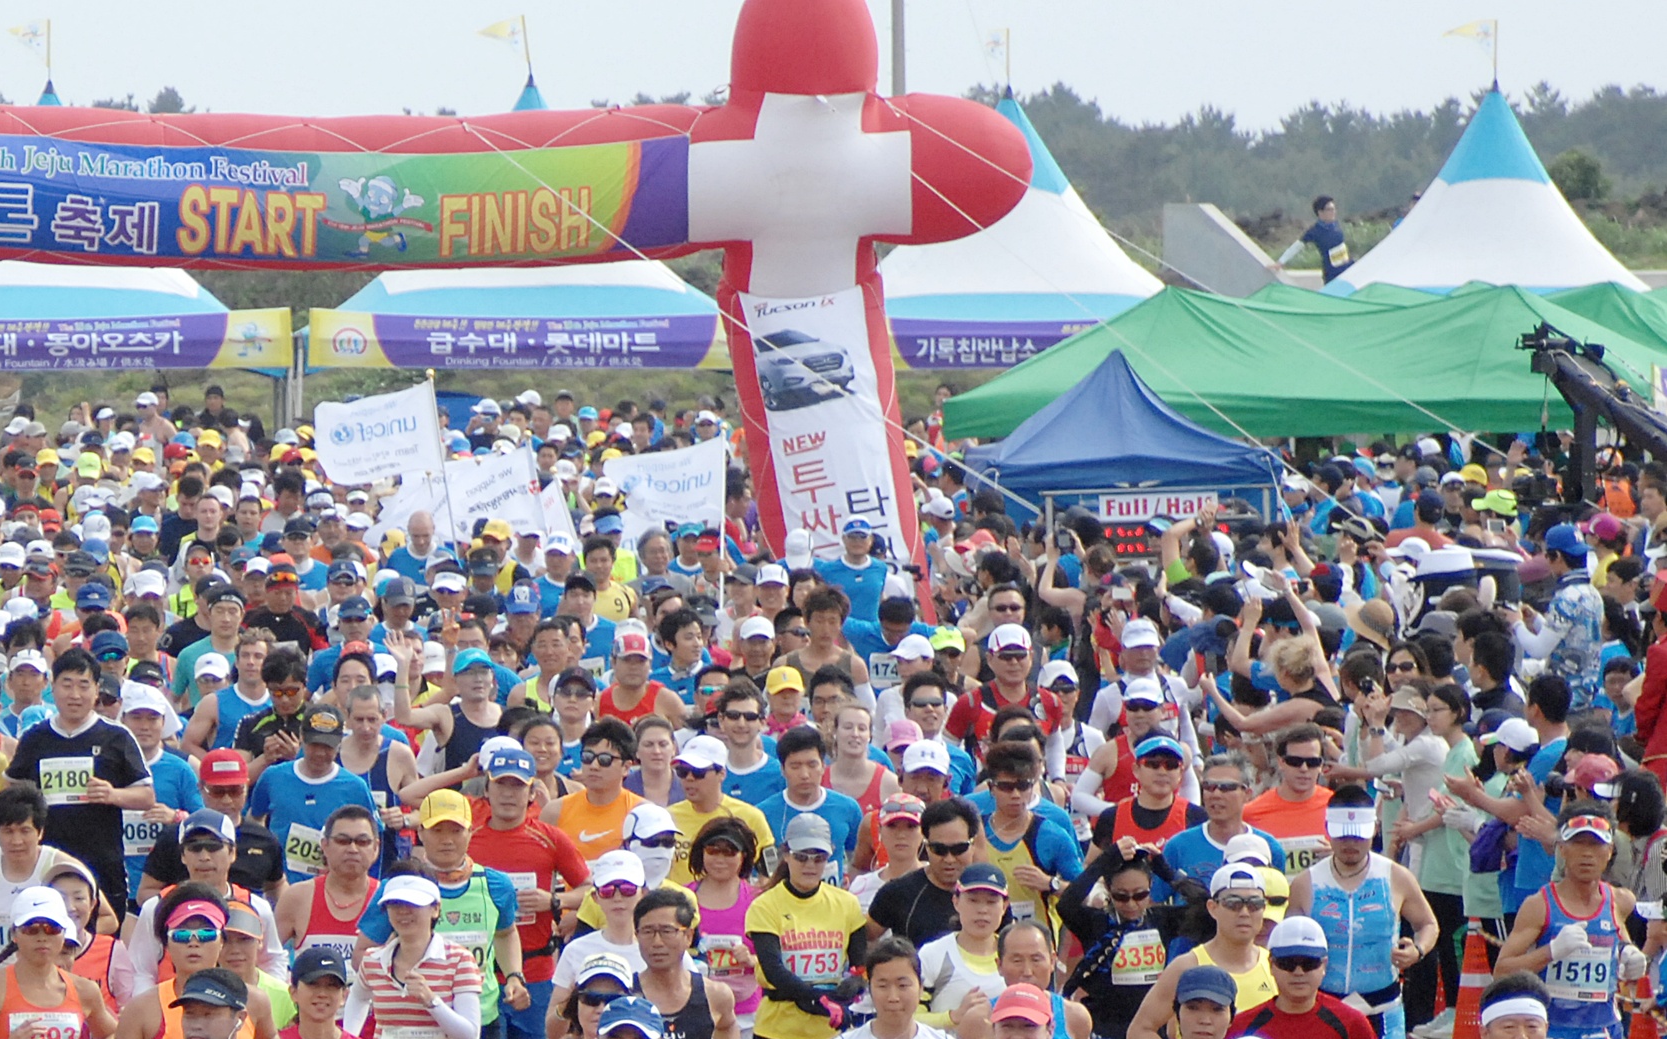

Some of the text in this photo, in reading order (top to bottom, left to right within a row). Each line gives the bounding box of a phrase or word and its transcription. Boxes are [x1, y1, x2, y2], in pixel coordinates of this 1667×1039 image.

[21, 144, 74, 177] Jeju
[78, 150, 205, 181] Marathon
[208, 156, 309, 187] Festival
[50, 192, 160, 254] 축제
[176, 182, 327, 260] START
[438, 185, 593, 259] FINISH
[43, 330, 185, 355] 동아오츠카
[426, 332, 661, 355] 급수대 롯데마트
[914, 336, 1037, 360] 기록칩반납소
[5, 358, 50, 369] Fountain
[445, 356, 490, 368] Drinking
[493, 356, 538, 366] Fountain
[781, 430, 827, 454] NEW
[1105, 498, 1148, 517] Full
[613, 596, 624, 613] 9
[872, 661, 900, 678] 174
[43, 770, 90, 790] 2180
[124, 822, 160, 842] 068
[286, 834, 324, 862] 205
[780, 928, 844, 951] diadora
[785, 952, 840, 975] 1753
[1114, 945, 1167, 970] 3356
[1551, 960, 1608, 984] 1519
